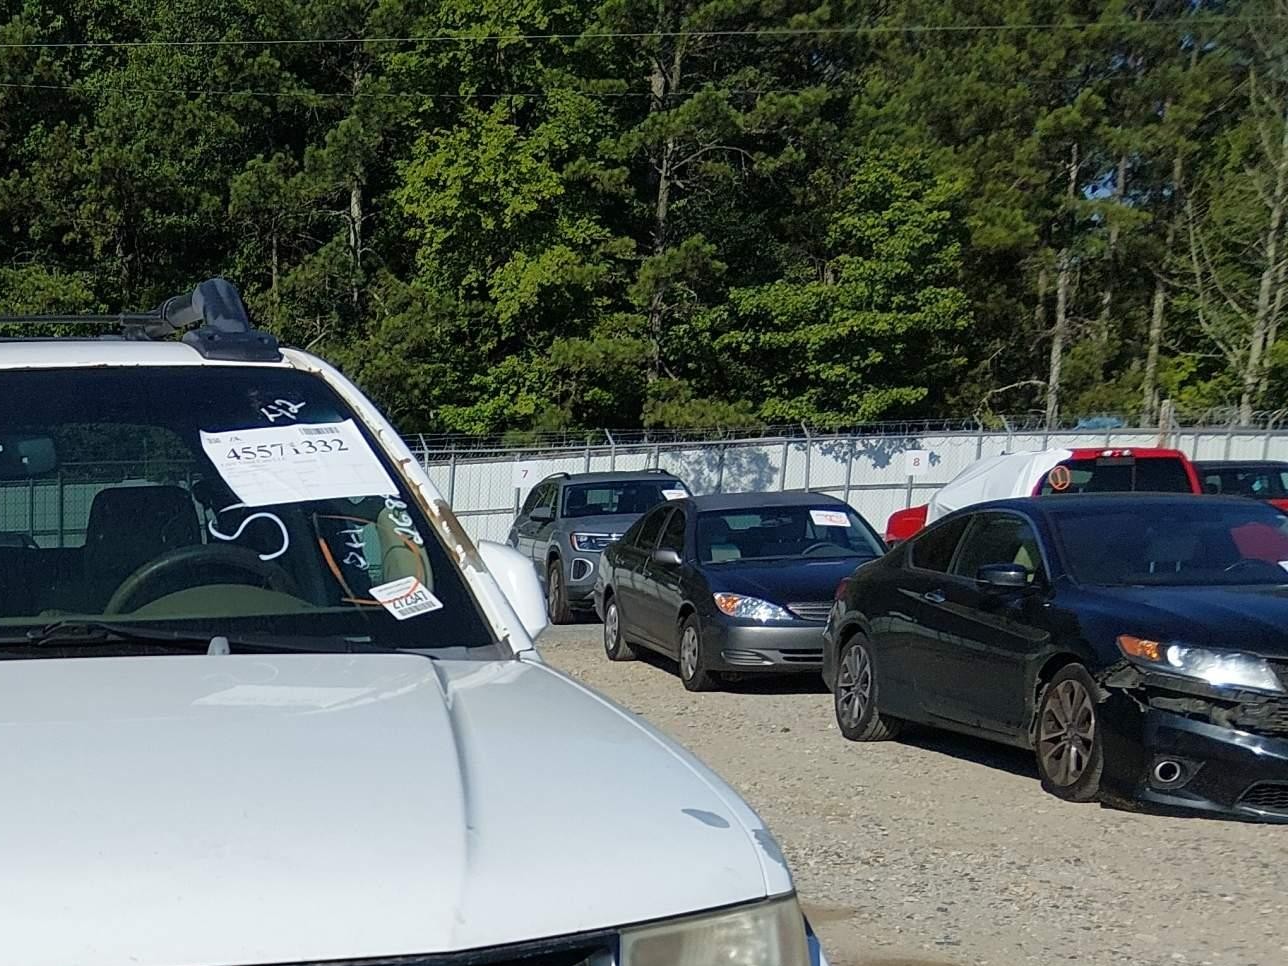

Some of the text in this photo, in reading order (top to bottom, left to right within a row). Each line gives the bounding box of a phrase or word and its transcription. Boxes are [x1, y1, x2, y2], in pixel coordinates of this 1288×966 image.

[226, 438, 349, 461] 45571332
[913, 457, 921, 467] 8
[521, 469, 529, 478] 7
